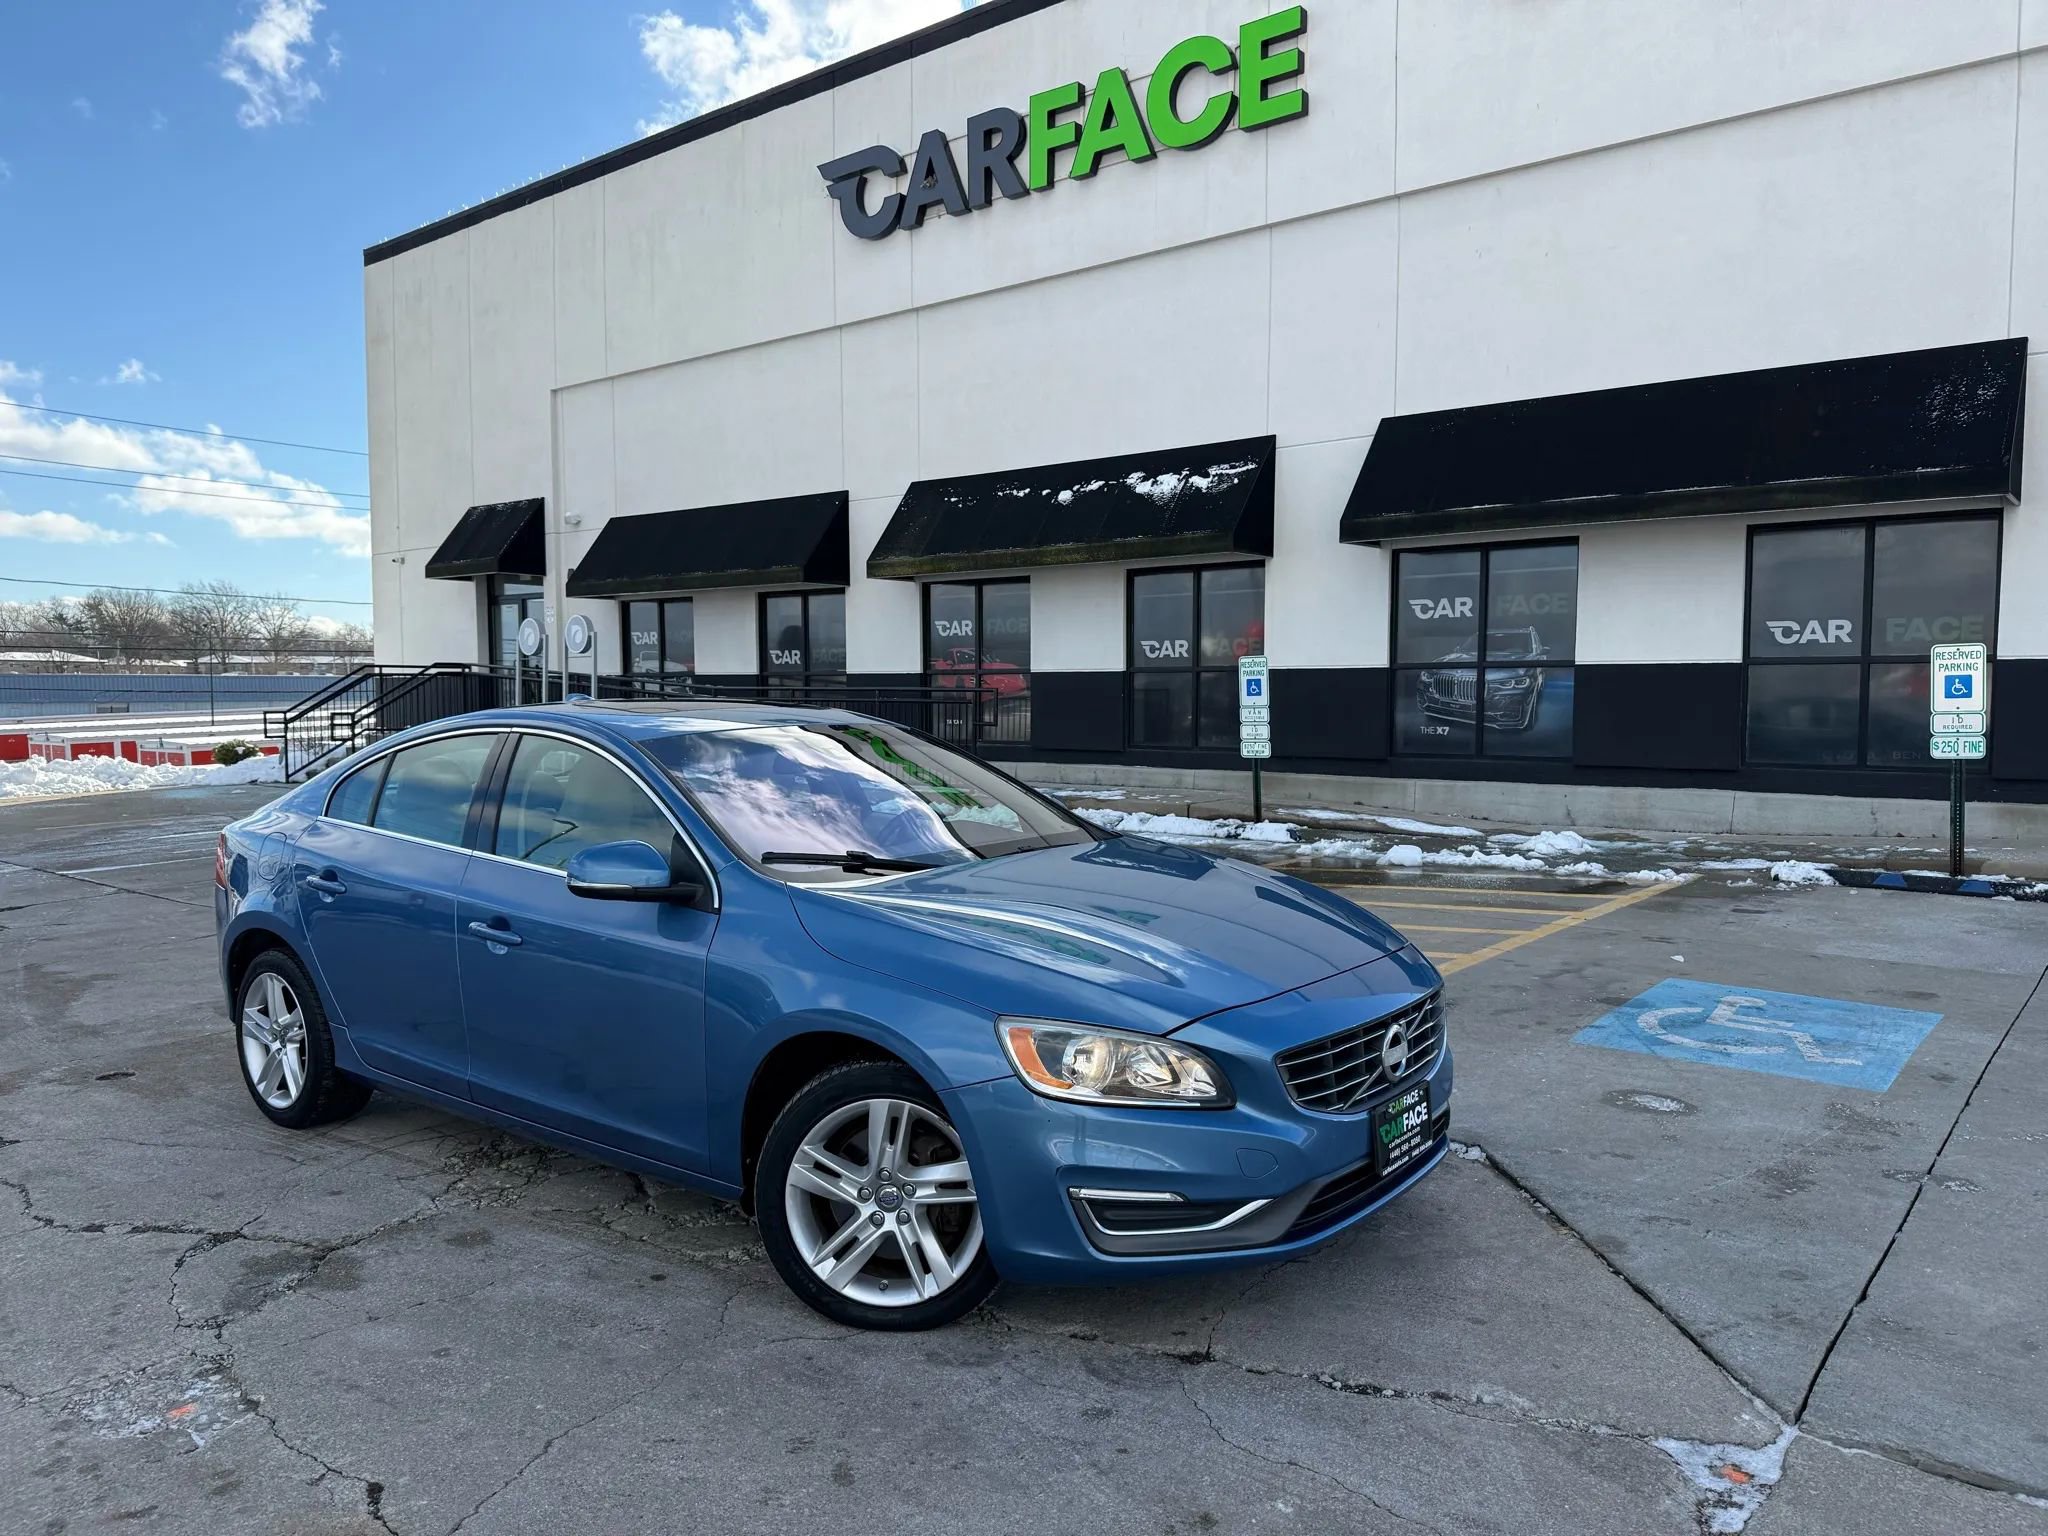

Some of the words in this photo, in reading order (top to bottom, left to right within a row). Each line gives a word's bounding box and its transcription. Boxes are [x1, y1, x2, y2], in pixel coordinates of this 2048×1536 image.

[817, 5, 1308, 241] CARFACE
[1408, 597, 1473, 619] CAR
[934, 620, 973, 637] CAR
[1765, 619, 1852, 644] CAR
[1885, 615, 1984, 643] FACE
[631, 631, 658, 645] CAR
[769, 649, 801, 664] CAR
[1140, 640, 1189, 658] CAR
[1936, 651, 1982, 661] RESERVED
[1243, 669, 1265, 677] PARKING
[1939, 663, 1979, 672] PARKING
[1420, 726, 1435, 735] THE
[1436, 726, 1450, 736] X7
[1963, 740, 1983, 754] FINE
[1388, 1089, 1419, 1114] CARFACE
[1380, 1102, 1428, 1143] CARFACE
